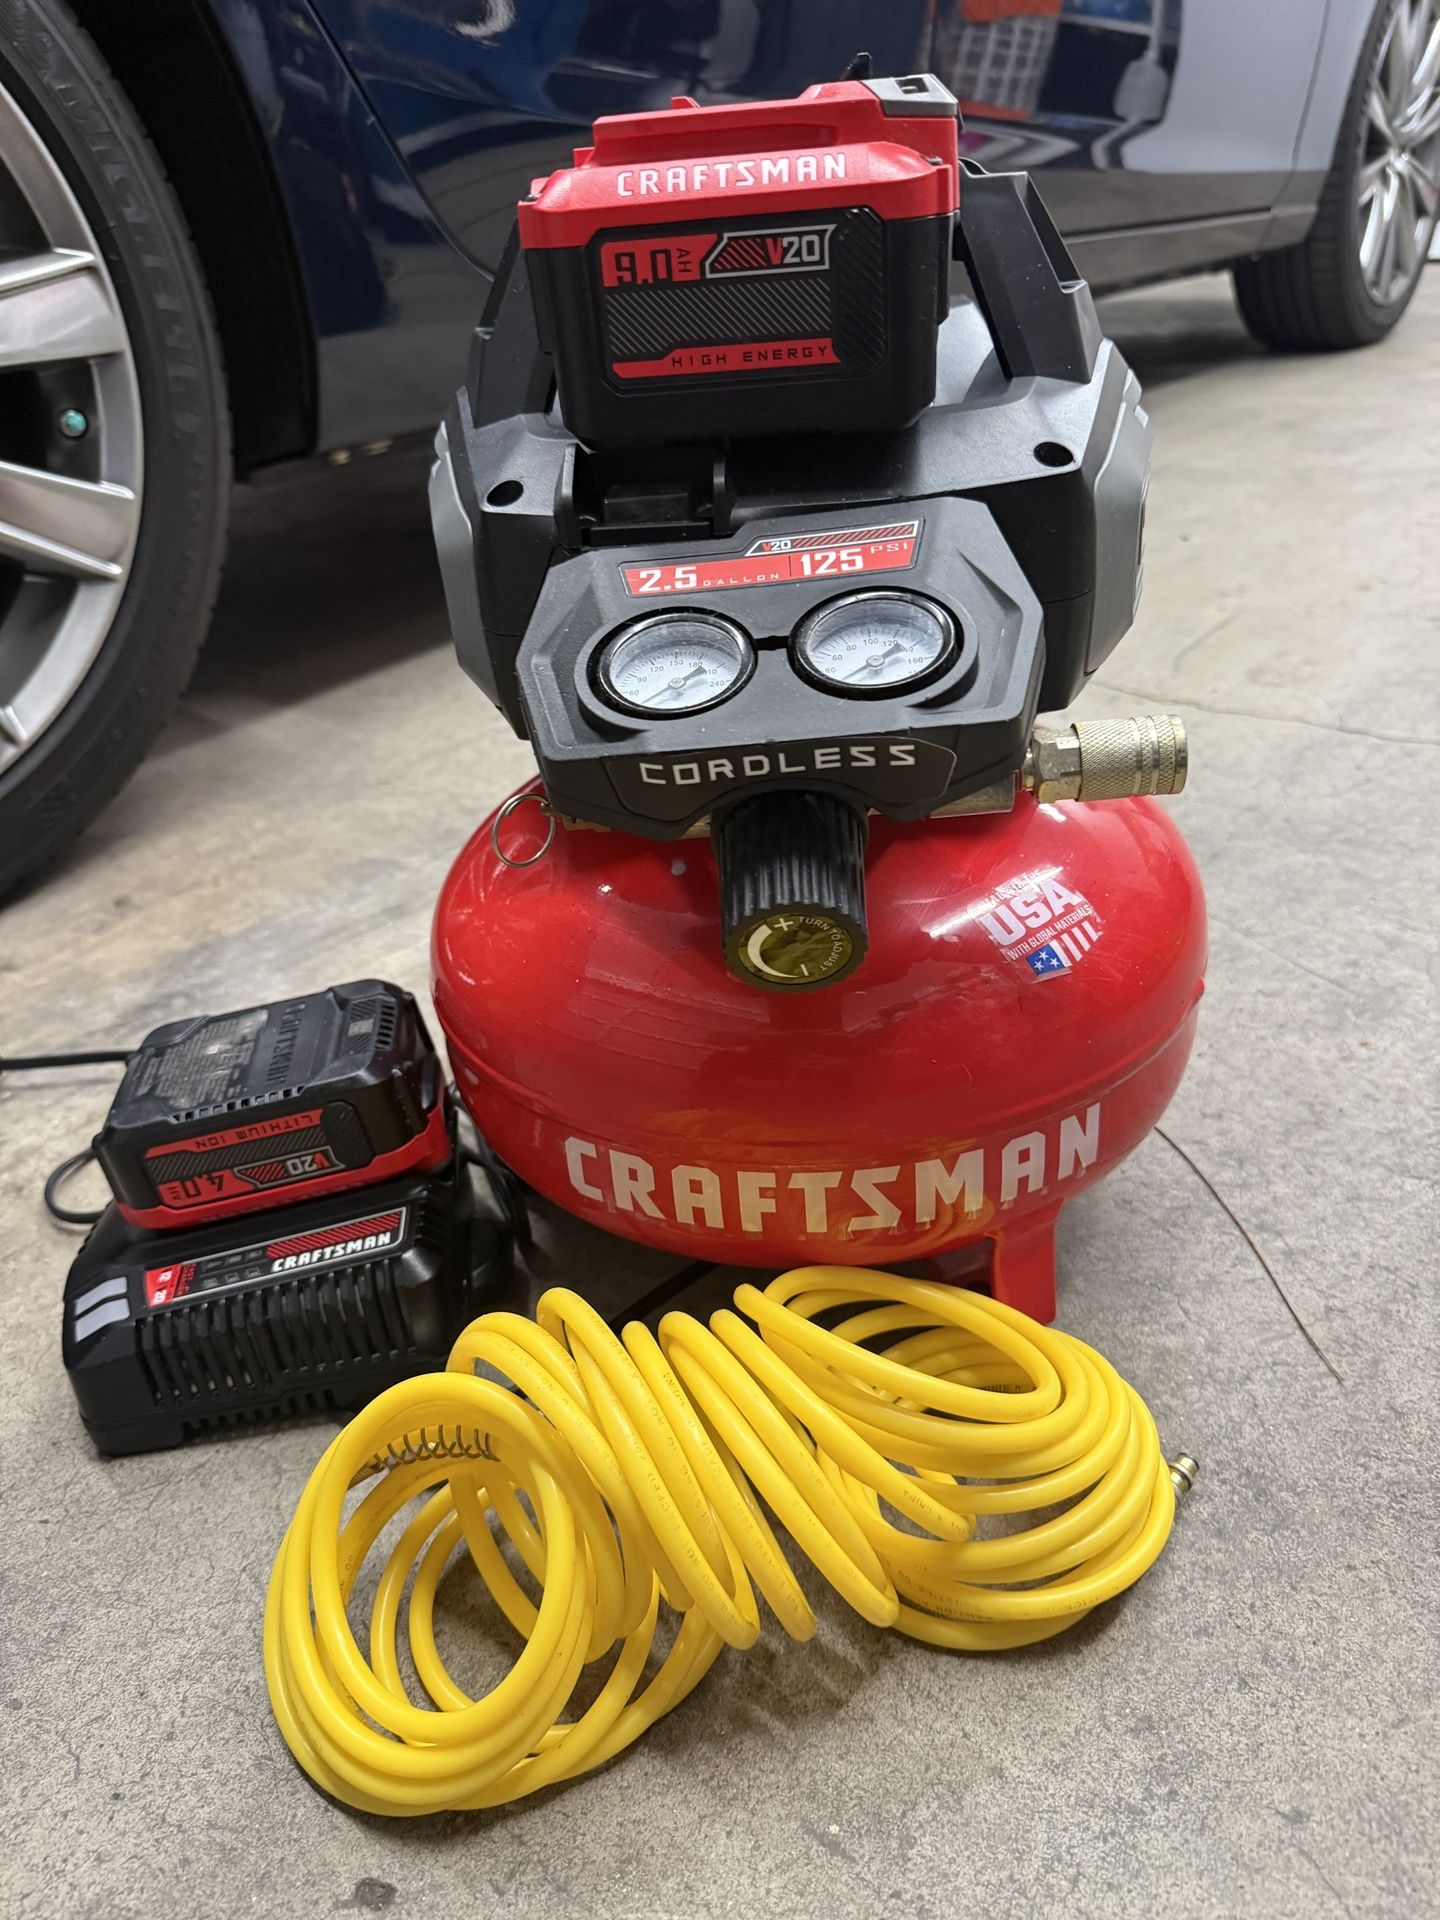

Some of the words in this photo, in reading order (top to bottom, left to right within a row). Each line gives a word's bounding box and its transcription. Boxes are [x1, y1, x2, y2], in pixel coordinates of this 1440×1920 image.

[616, 152, 848, 198] CRAFTSMAN
[766, 233, 821, 266] V20
[614, 248, 673, 285] 9.0
[676, 247, 692, 274] AH
[671, 351, 728, 368] HIGH
[742, 345, 828, 363] ENERGY
[762, 540, 792, 551] V20
[638, 565, 698, 593] 2.5
[702, 573, 780, 587] GALLON
[799, 547, 865, 577] 125
[869, 543, 909, 555] PSI
[846, 644, 857, 652] 80
[863, 637, 879, 646] 100
[882, 639, 899, 647] 120
[908, 656, 924, 665] 160
[629, 689, 639, 697] 60
[650, 665, 664, 673] 120
[670, 659, 684, 667] 150
[688, 661, 703, 669] 180
[709, 680, 725, 688] 240
[639, 744, 917, 785] CORDLESS
[799, 916, 830, 931] TURN
[979, 878, 1084, 946] USA
[828, 929, 841, 940] TO
[1007, 942, 1032, 961] WITH
[1027, 925, 1058, 949] GLOBAL
[1053, 903, 1093, 933] MATERIALS
[819, 941, 843, 972] ADJUST
[196, 1135, 227, 1149] ION
[236, 1114, 314, 1140] LITHIUM
[286, 1151, 331, 1176] V20
[563, 1102, 1101, 1233] CRAFTSMAN
[184, 1174, 225, 1199] 4.0
[271, 1231, 392, 1273] CRAFTSMAN
